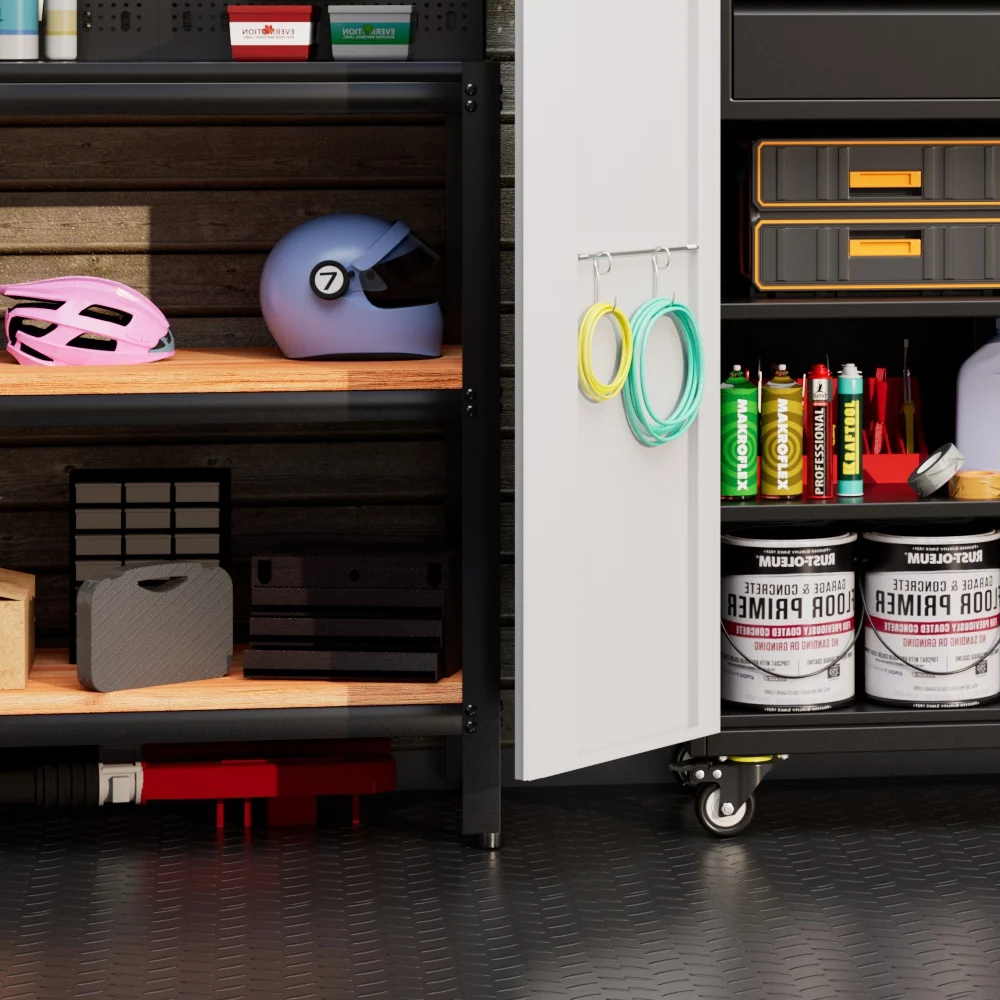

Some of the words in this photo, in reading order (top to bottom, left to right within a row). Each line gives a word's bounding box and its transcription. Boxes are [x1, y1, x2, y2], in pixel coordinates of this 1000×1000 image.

[319, 272, 337, 290] 7
[737, 398, 748, 491] MAKROFLEX
[777, 398, 789, 491] MAKROFLEX
[814, 407, 825, 495] PROFESSIONAL
[843, 400, 856, 475] KRAFTOOL
